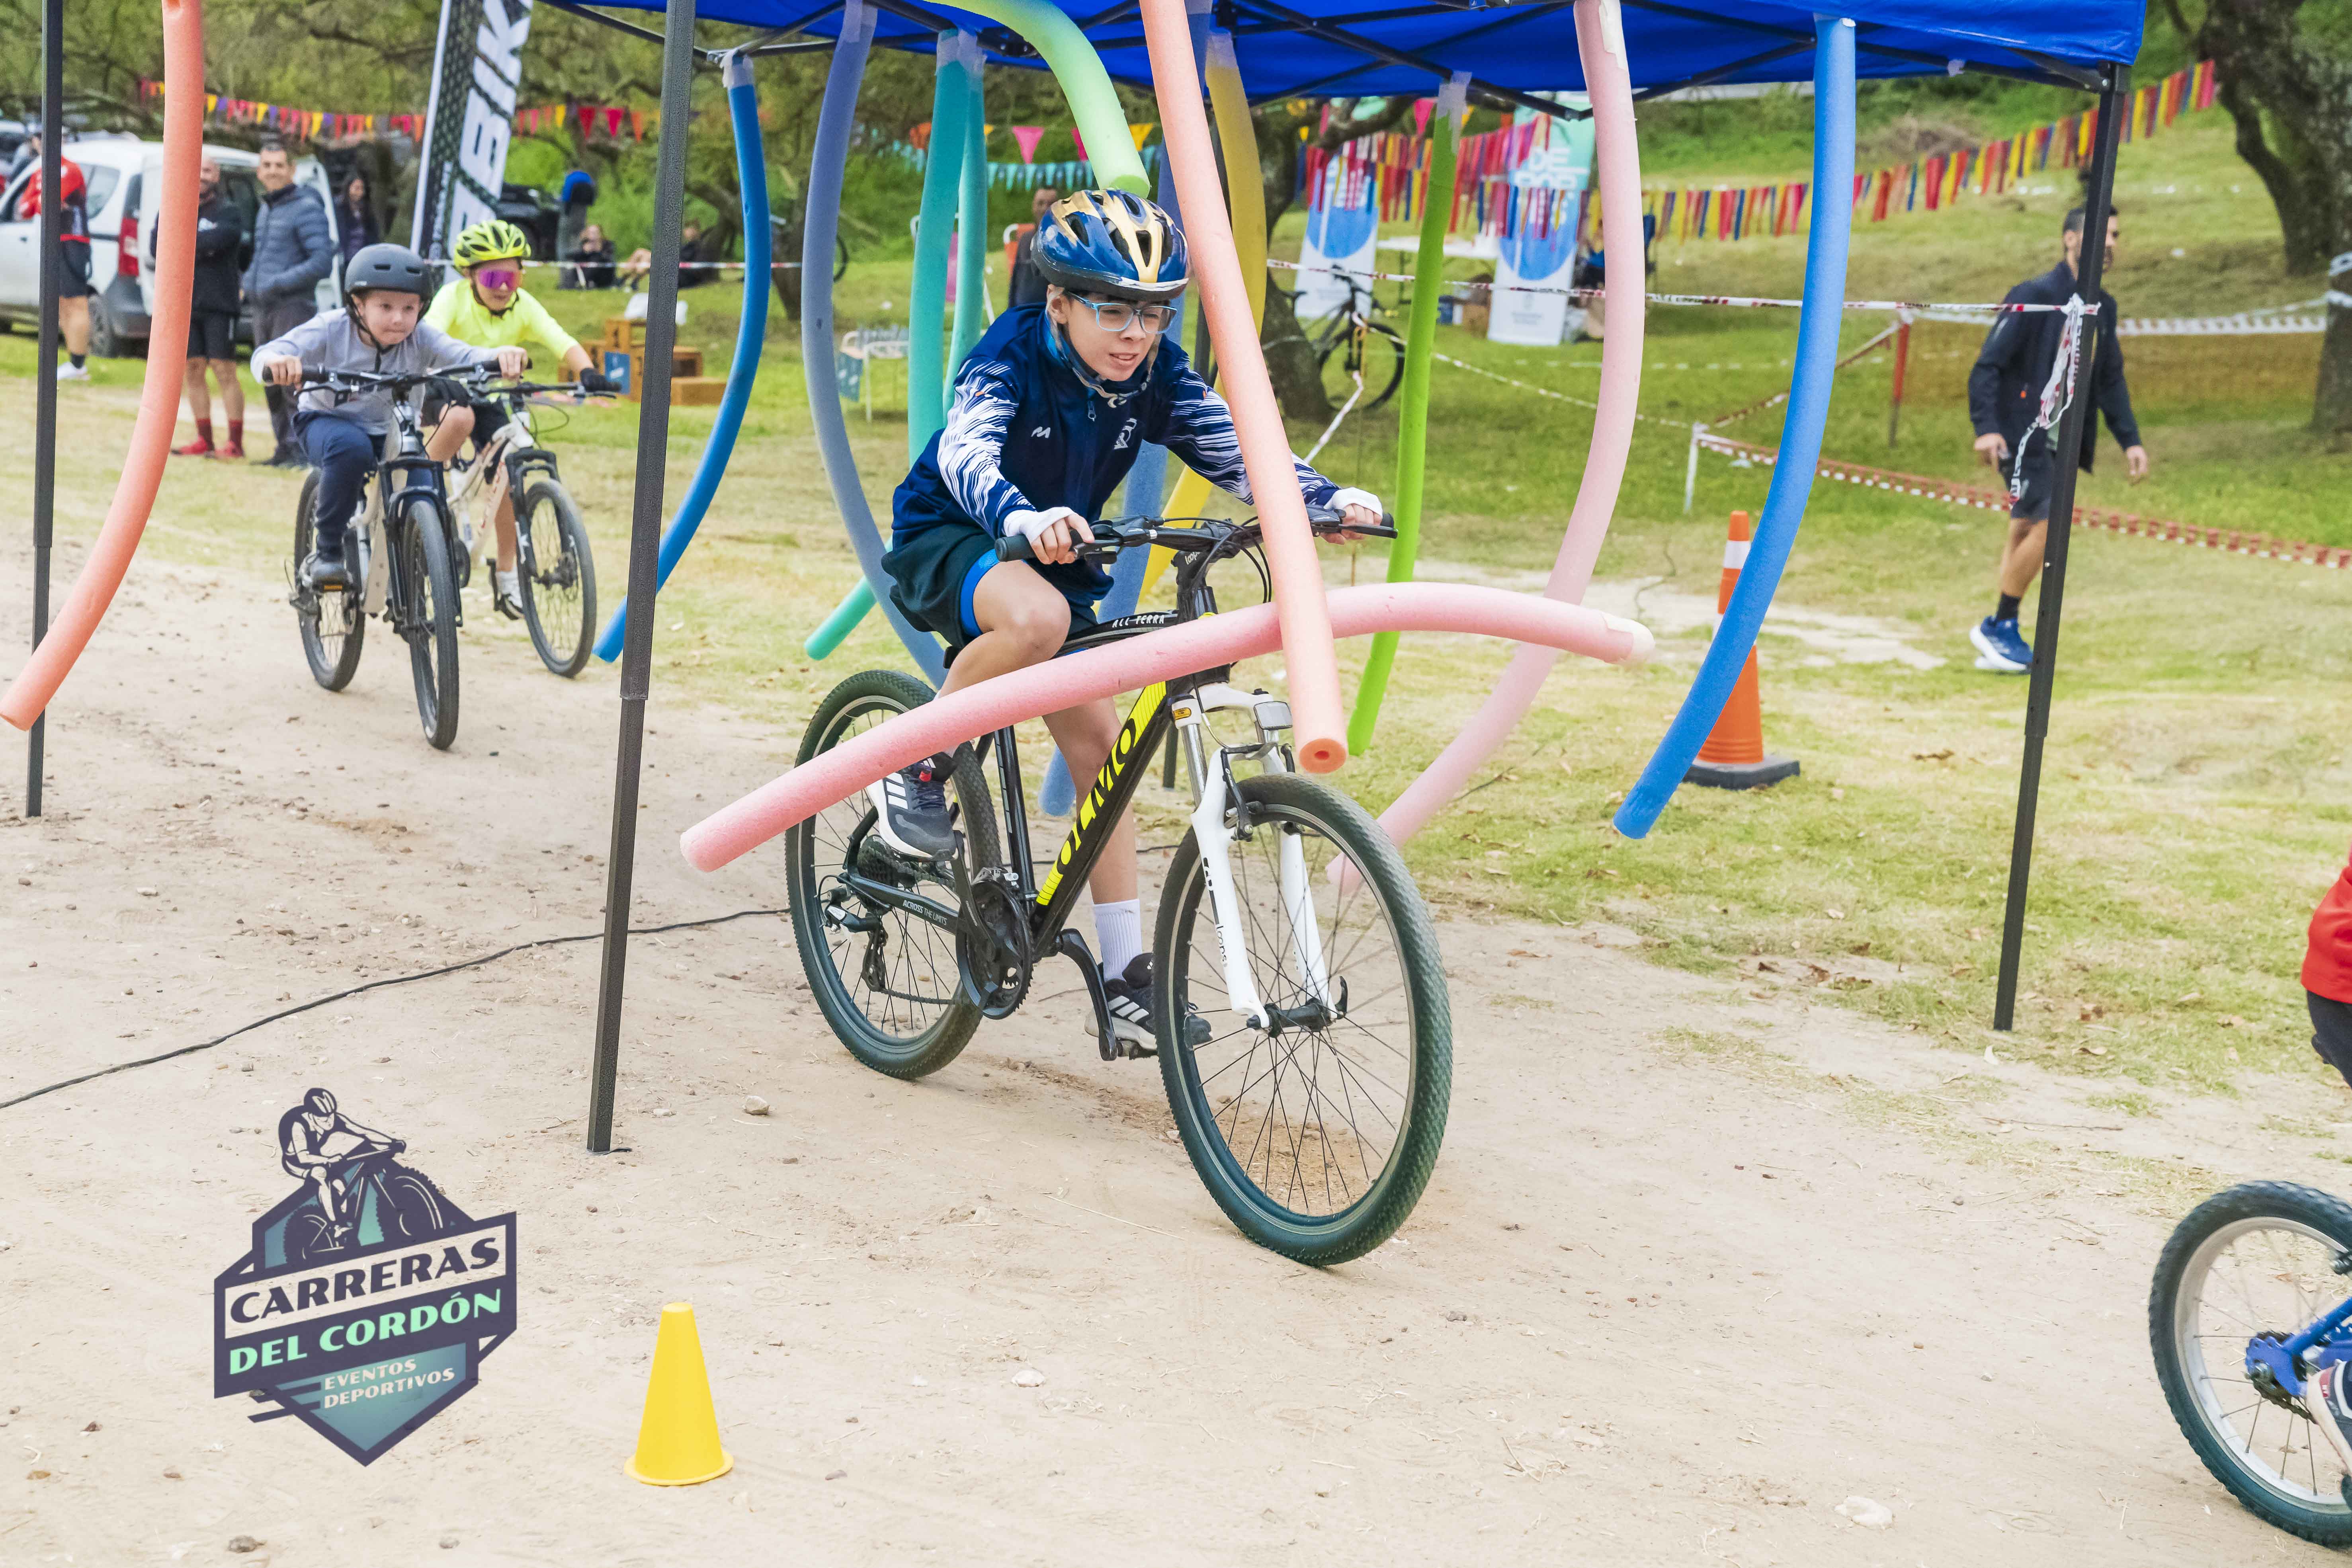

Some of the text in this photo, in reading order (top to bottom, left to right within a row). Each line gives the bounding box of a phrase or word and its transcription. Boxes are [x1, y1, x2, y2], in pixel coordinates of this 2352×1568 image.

[1057, 718, 1135, 875] OLMO
[903, 900, 947, 926] ACROSS THE LIMITS
